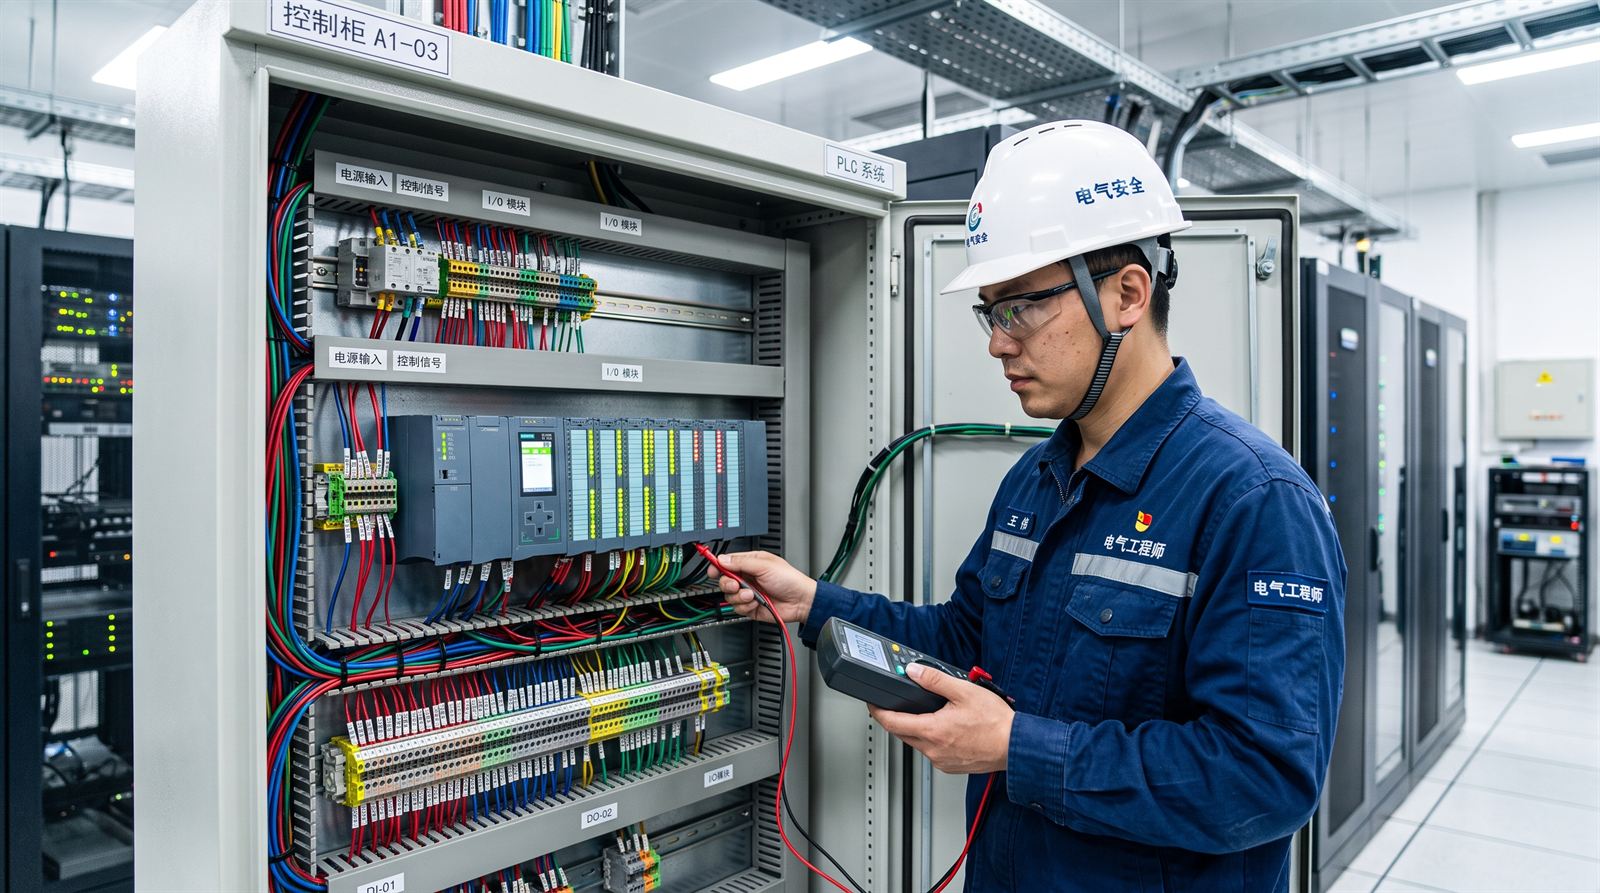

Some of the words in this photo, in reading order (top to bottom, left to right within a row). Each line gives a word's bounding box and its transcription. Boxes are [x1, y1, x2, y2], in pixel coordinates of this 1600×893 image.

[283, 3, 366, 45] 控制柜
[374, 28, 438, 61] A1-03
[340, 168, 388, 187] 电源输入
[837, 155, 858, 174] PLC
[861, 161, 885, 183] 系统
[400, 178, 445, 197] 控制信号
[1075, 176, 1145, 206] 电气安全
[506, 197, 527, 212] 模块
[334, 351, 382, 366] 电源输入
[397, 354, 442, 369] 控制信号
[1007, 515, 1019, 528] 王
[1103, 534, 1167, 560] 电气工程师
[1253, 579, 1324, 604] 电气工程师
[586, 808, 613, 824] DO-02
